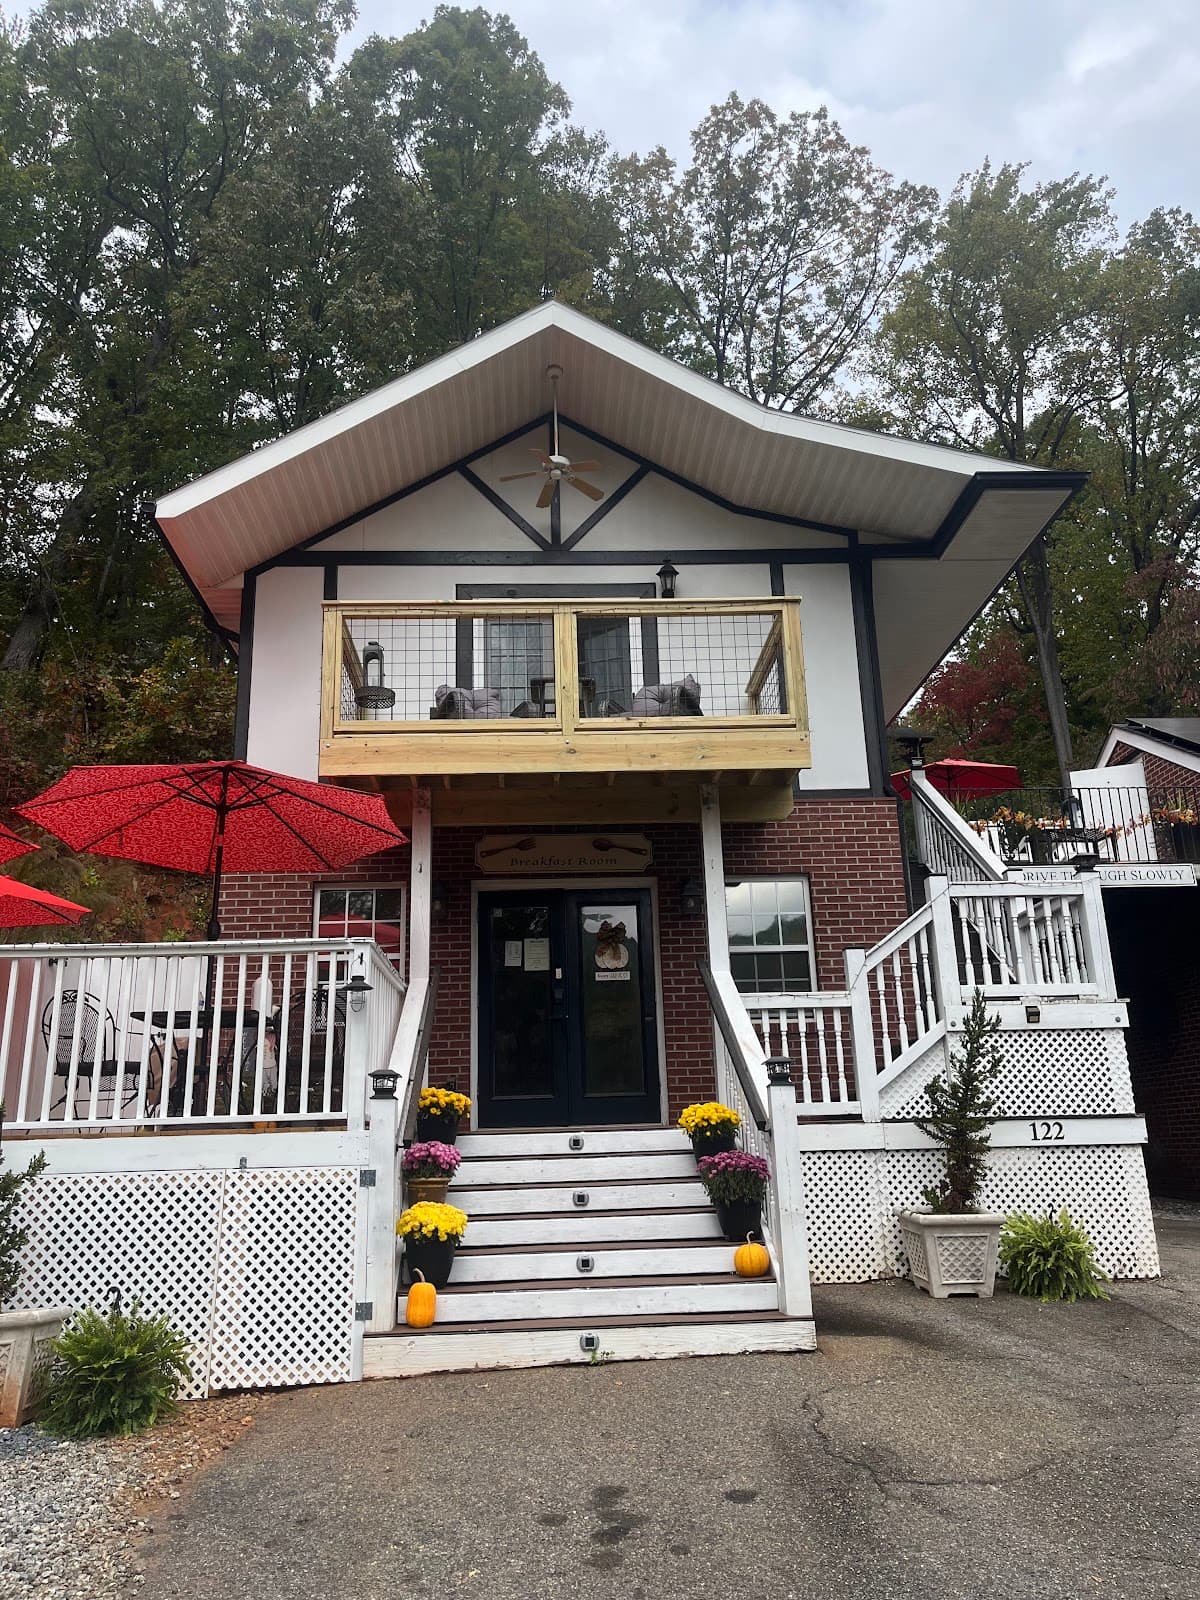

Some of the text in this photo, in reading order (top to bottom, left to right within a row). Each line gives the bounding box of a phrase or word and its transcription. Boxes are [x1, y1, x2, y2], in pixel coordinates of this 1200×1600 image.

[510, 855, 617, 867] Breakfast Room
[1130, 870, 1184, 881] SLOWLY
[1029, 1121, 1065, 1141] 122
